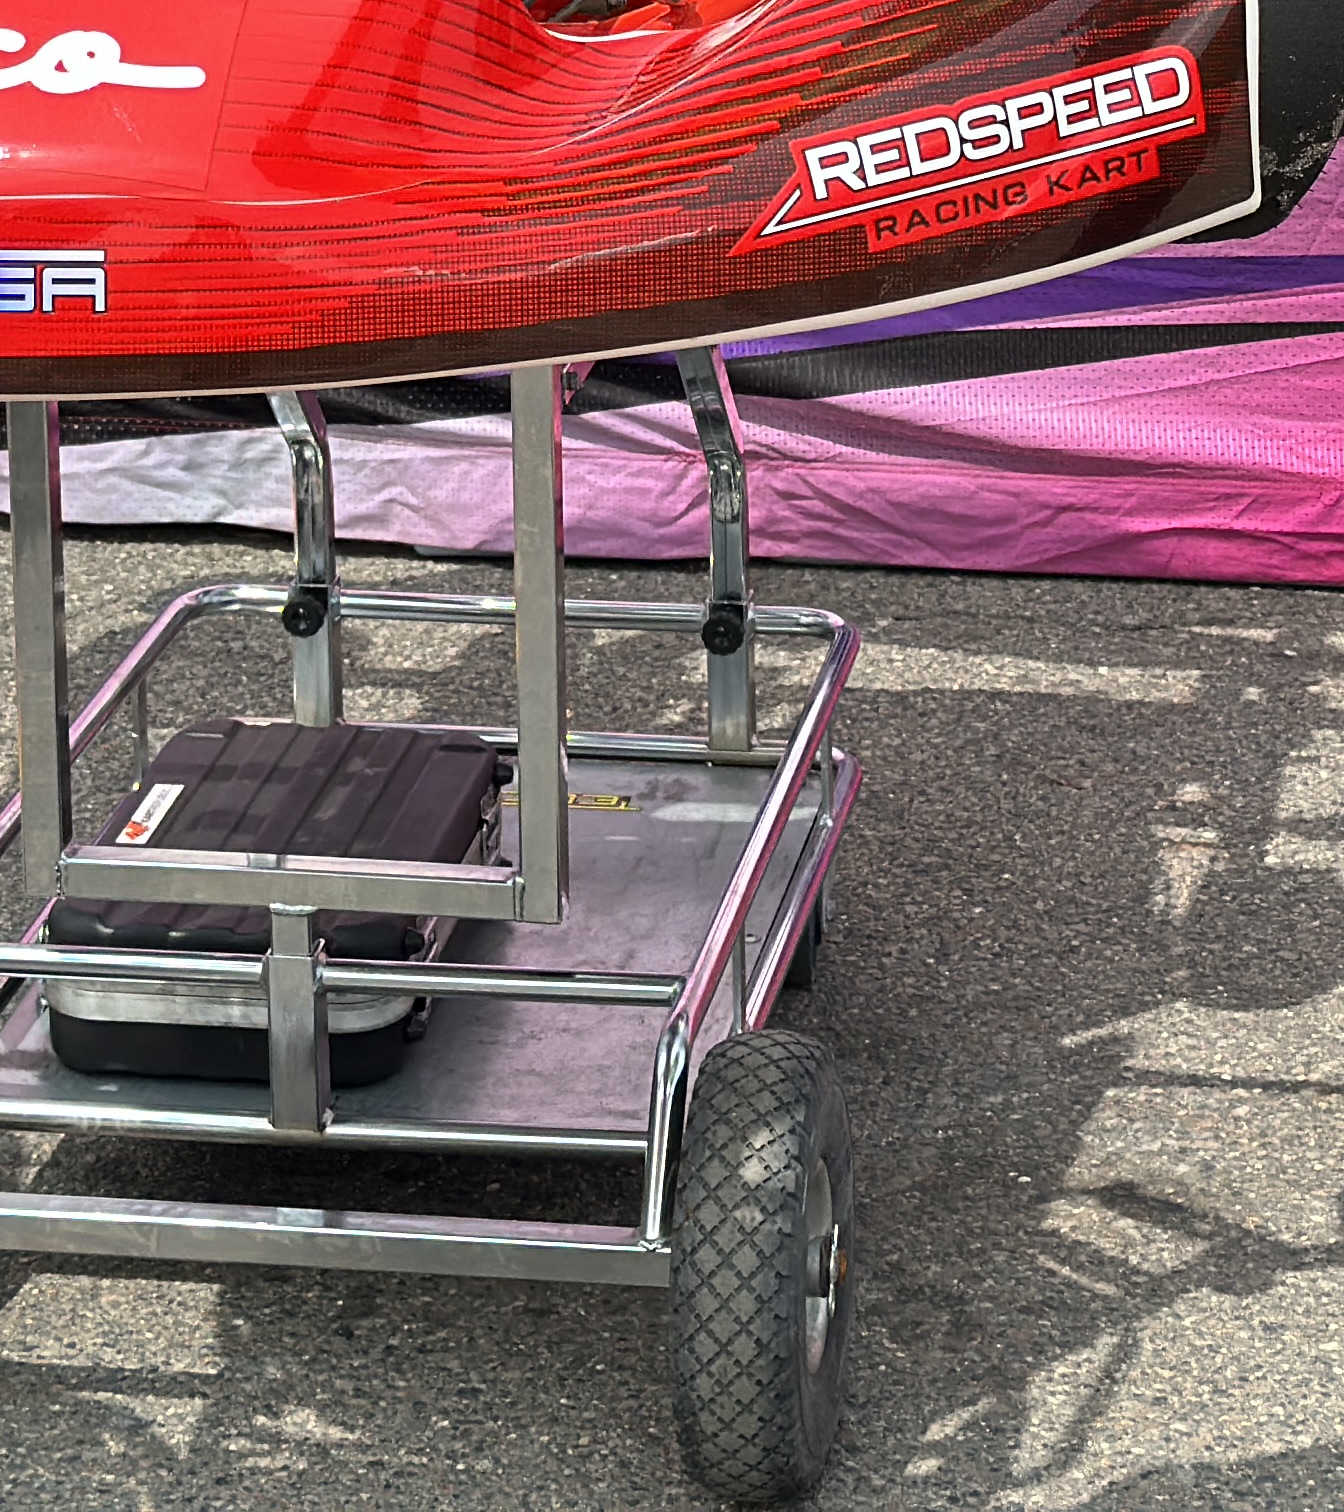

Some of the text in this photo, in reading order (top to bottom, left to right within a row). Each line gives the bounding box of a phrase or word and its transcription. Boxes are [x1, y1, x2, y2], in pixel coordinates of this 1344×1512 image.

[805, 57, 1191, 200] REDSPEED
[875, 149, 1150, 241] RACING KART
